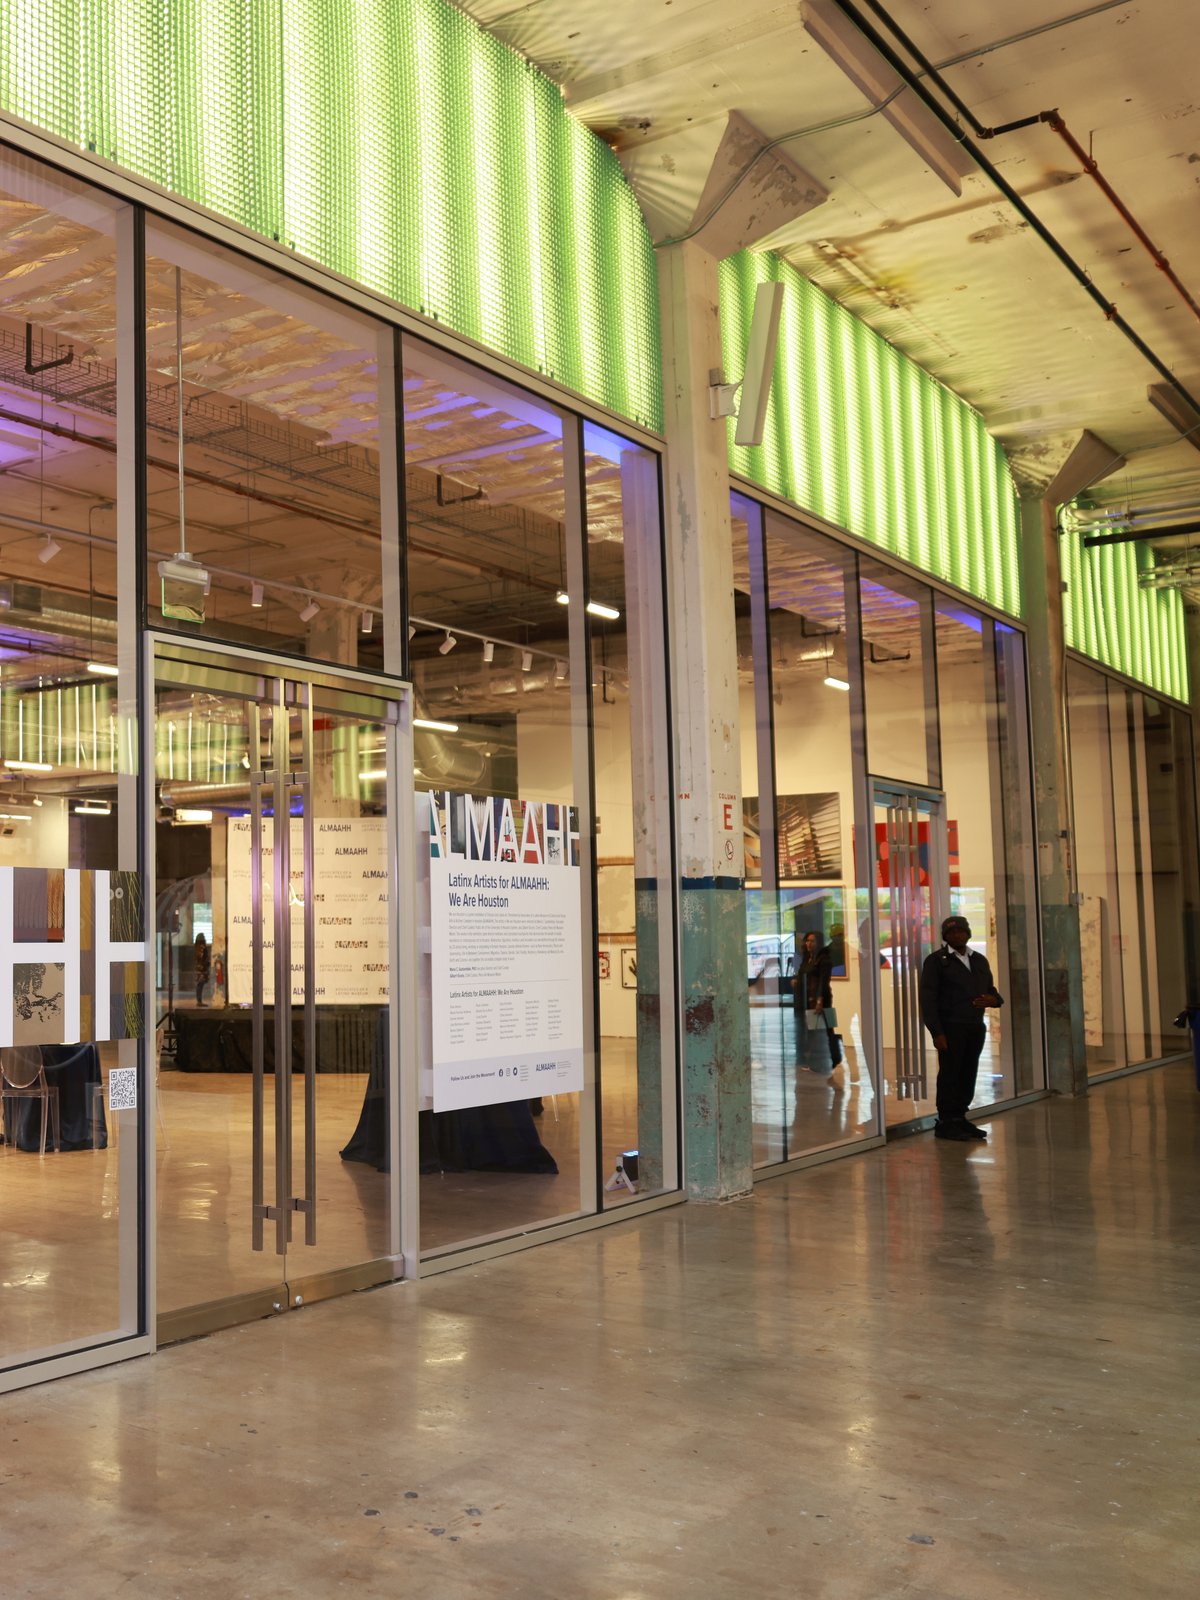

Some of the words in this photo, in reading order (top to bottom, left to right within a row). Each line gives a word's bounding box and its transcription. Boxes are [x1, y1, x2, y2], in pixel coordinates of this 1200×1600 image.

[718, 793, 737, 801] COLUMN
[723, 804, 734, 831] E
[319, 824, 352, 832] ALMAAHH
[335, 847, 368, 856] ALMAAHH
[362, 870, 389, 879] ALMAA
[448, 873, 472, 888] Latinx
[473, 874, 497, 889] Artists
[499, 875, 510, 889] for
[511, 876, 550, 890] ALMAAHH:
[448, 892, 461, 907] We
[463, 893, 476, 907] Are
[477, 893, 509, 908] Houston
[293, 987, 326, 996] ALMHH
[535, 1062, 556, 1072] ALMAAHH
